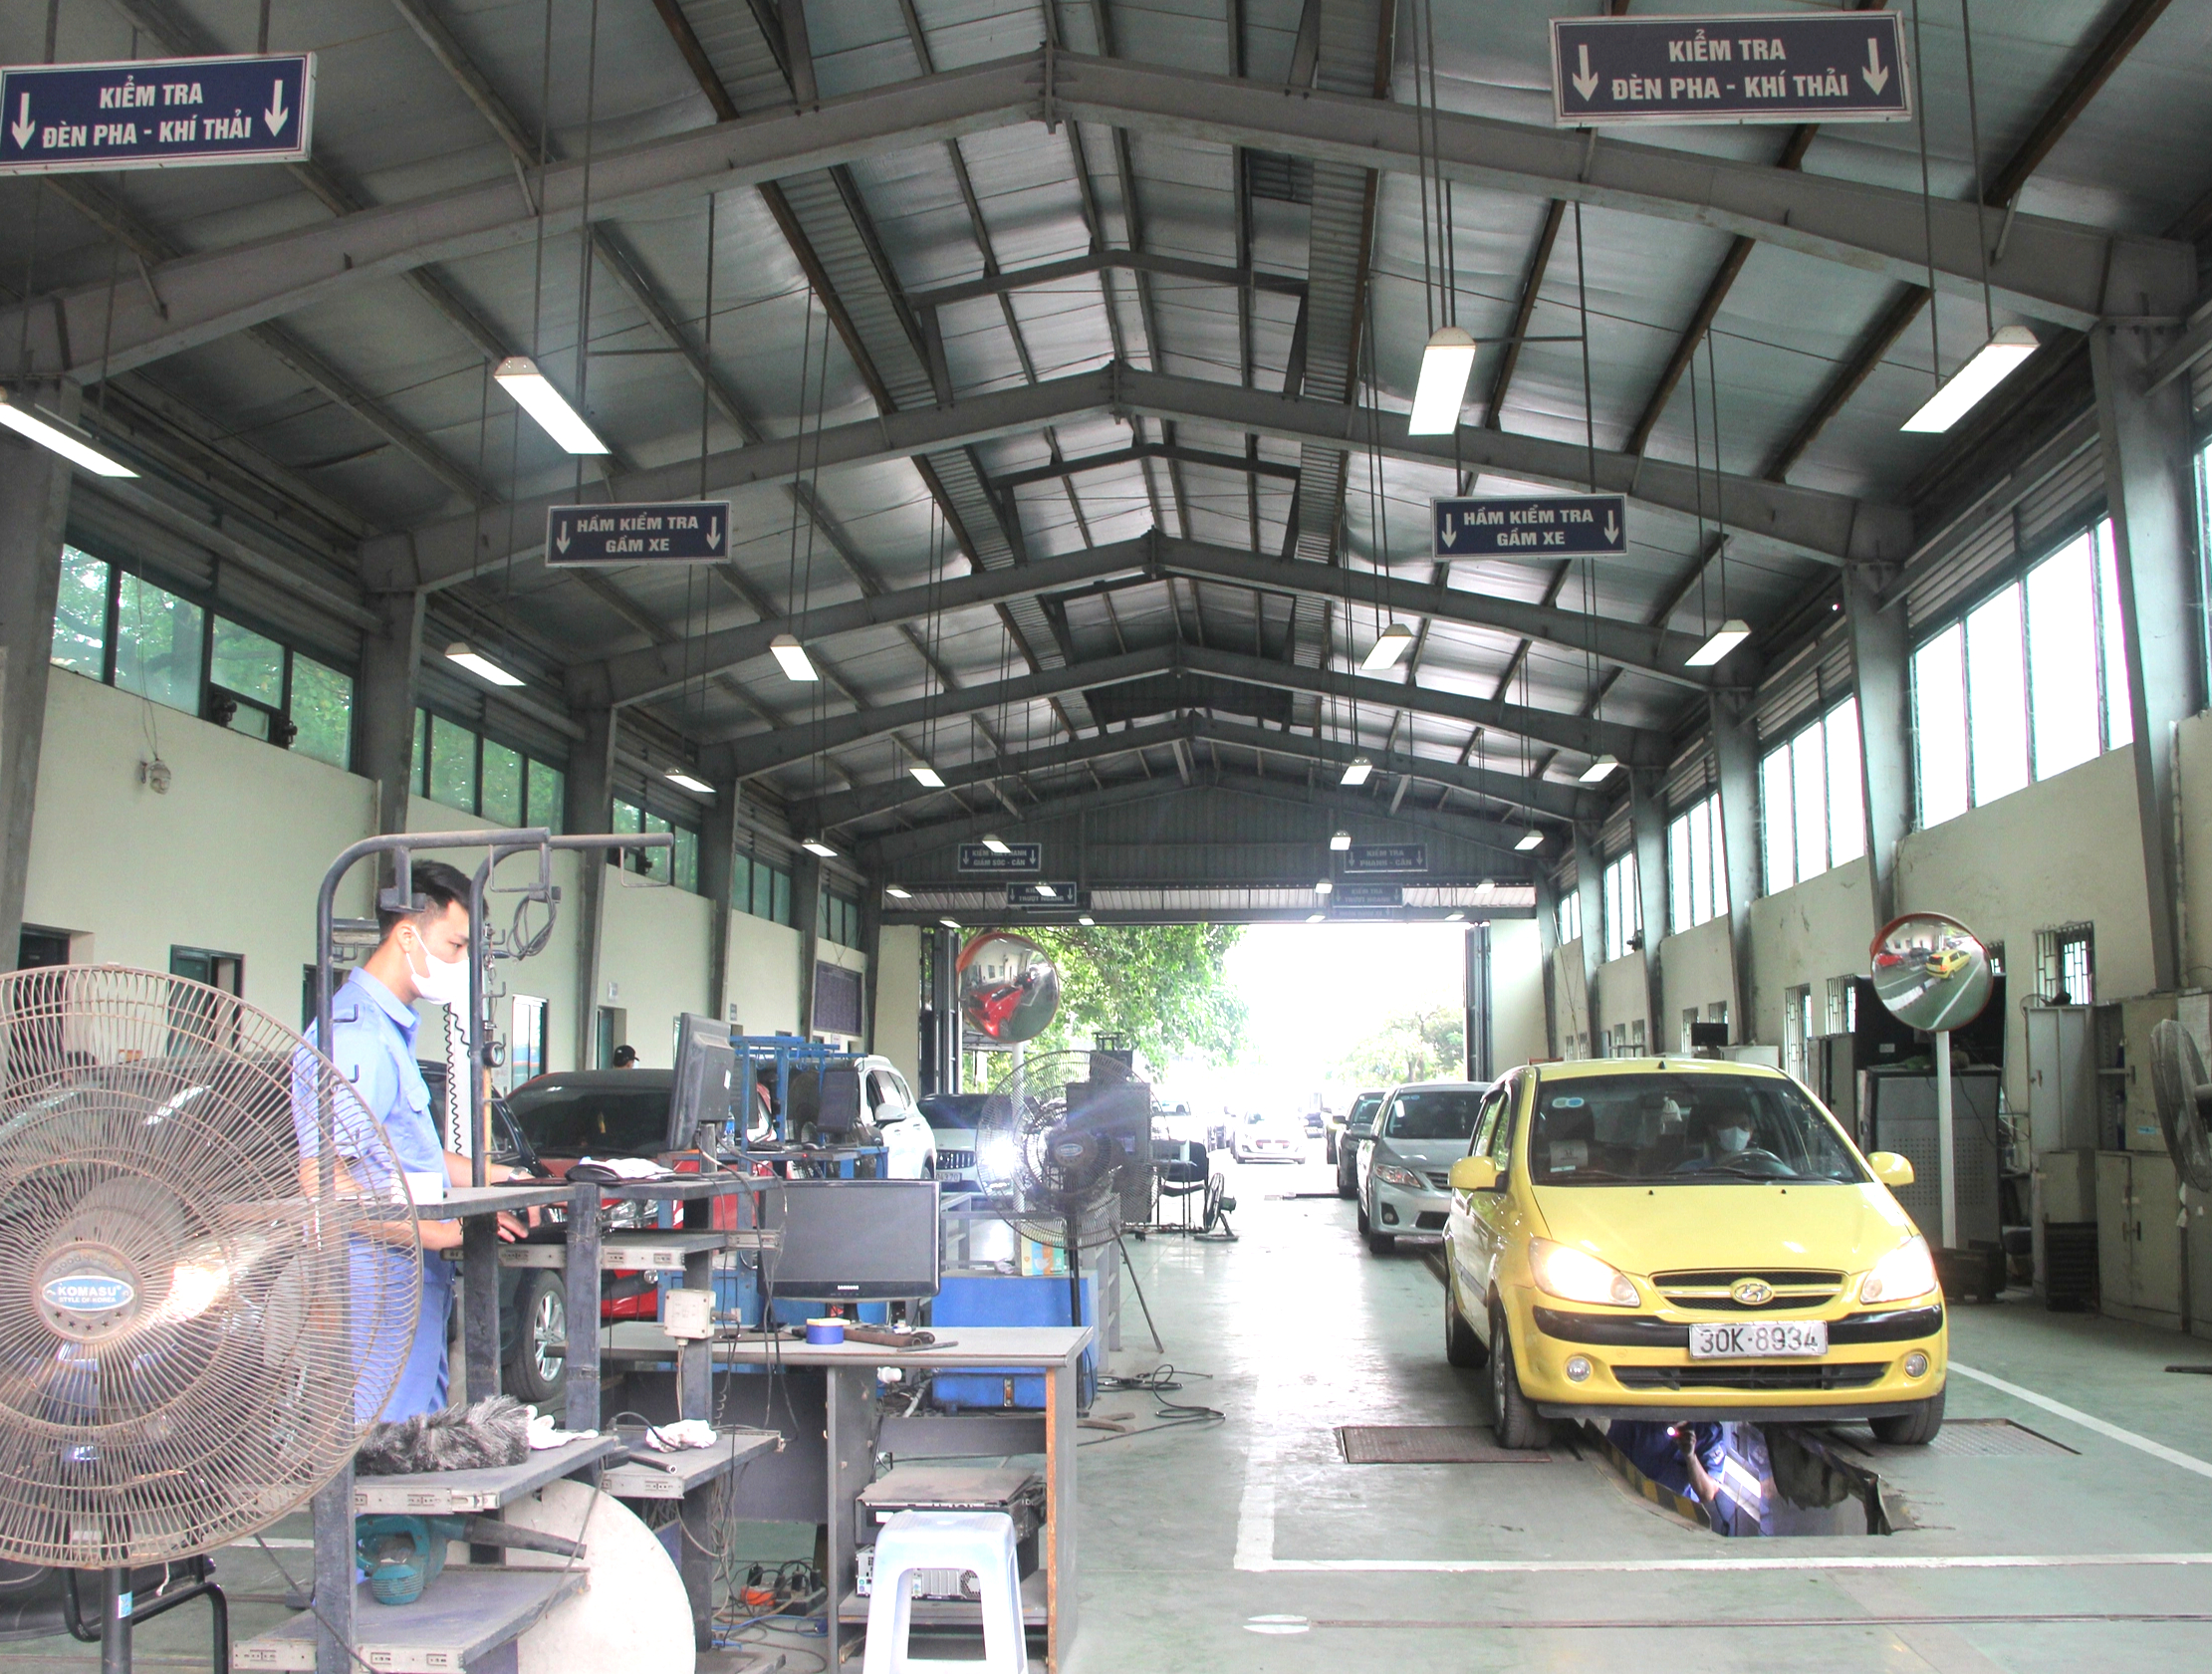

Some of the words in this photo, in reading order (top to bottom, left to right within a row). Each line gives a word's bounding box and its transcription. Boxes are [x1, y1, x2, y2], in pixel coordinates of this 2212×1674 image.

[1668, 28, 1732, 63] KIỂM
[1738, 38, 1787, 62] TRA
[100, 75, 156, 110] KIỂM
[162, 83, 203, 106] TRA
[1611, 73, 1662, 101] ĐÈN
[1669, 77, 1721, 100] PHA
[1744, 69, 1787, 99] KHÍ
[1792, 67, 1849, 98] THẢI
[43, 120, 88, 149] ĐÈN
[93, 122, 137, 146] PHA
[158, 114, 198, 143] KHÍ
[203, 108, 253, 140] THẢI
[577, 513, 614, 533] HẦM
[619, 511, 662, 532] KIỂM
[666, 516, 699, 530] TRA
[1463, 506, 1505, 526] HẦM
[1509, 504, 1555, 524] KIỂM
[1560, 509, 1594, 523] TRA
[605, 534, 643, 554] GẦM
[648, 538, 670, 552] XE
[1496, 527, 1538, 547] GẦM
[1543, 531, 1566, 545] XE
[58, 1286, 118, 1297] KOMASU
